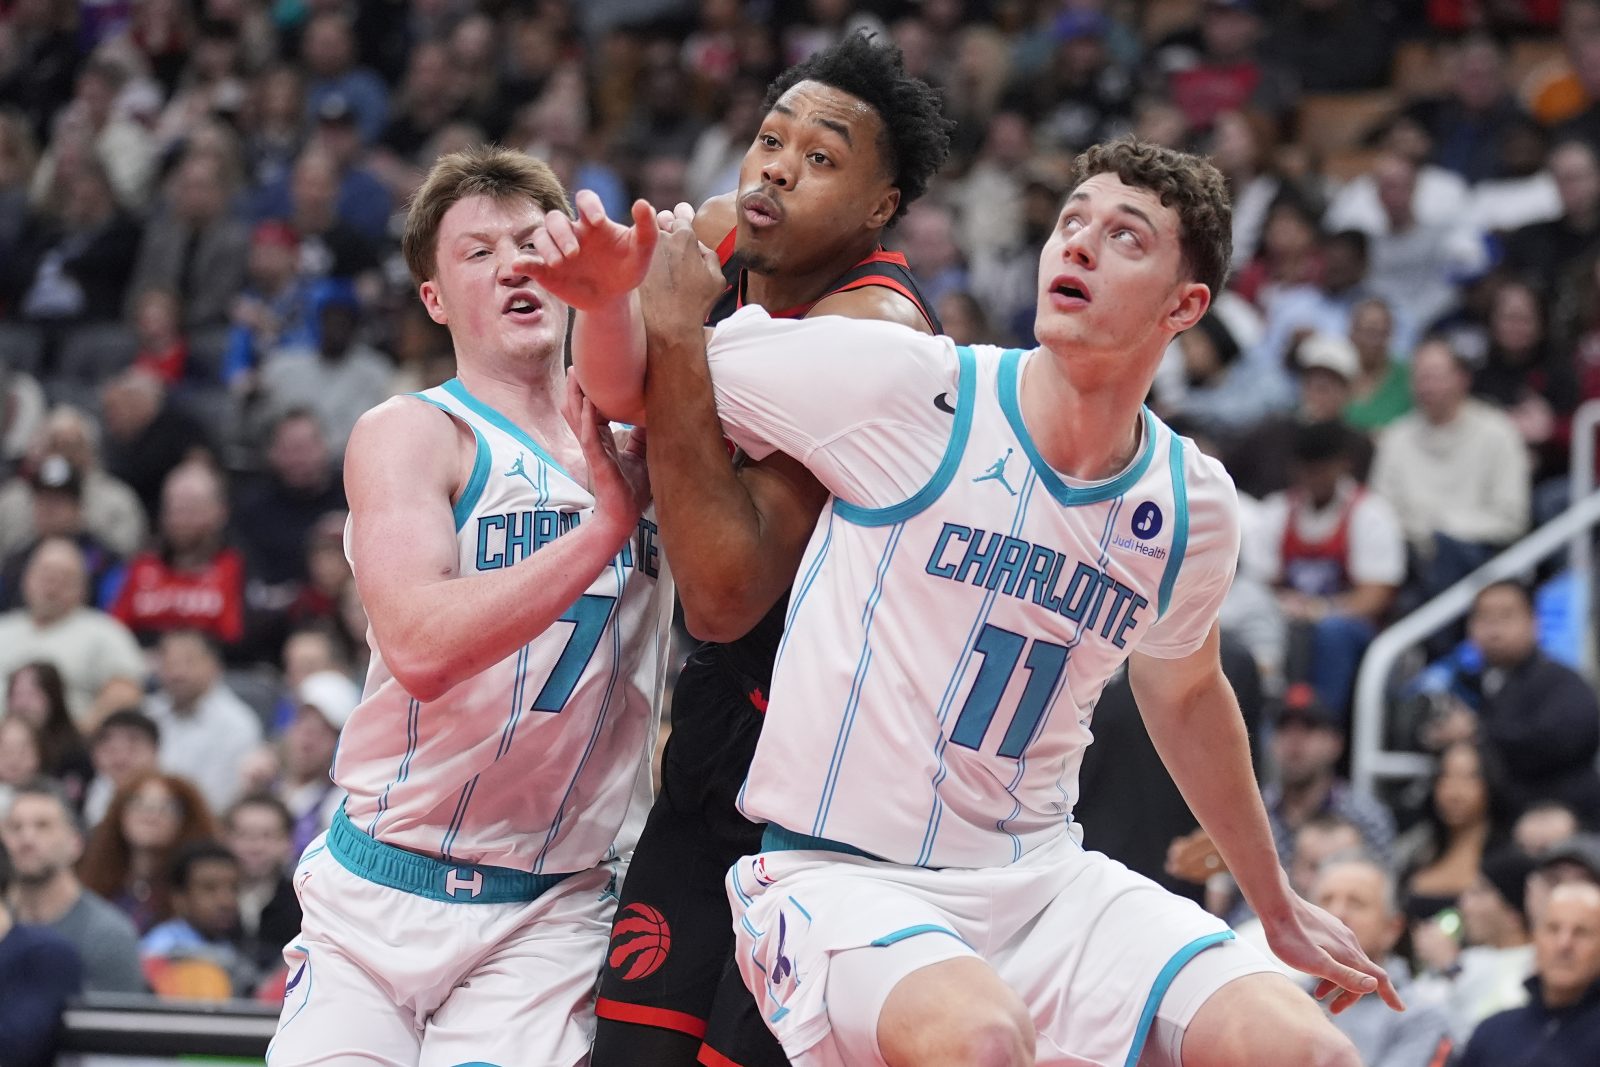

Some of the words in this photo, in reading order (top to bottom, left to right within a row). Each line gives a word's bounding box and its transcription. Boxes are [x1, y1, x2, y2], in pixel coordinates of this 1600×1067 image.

[925, 522, 1148, 649] CHARLOTTE
[1112, 534, 1134, 550] Judi
[1135, 541, 1166, 560] Health
[530, 593, 617, 713] 7
[949, 623, 1069, 759] 11
[445, 867, 484, 899] H
